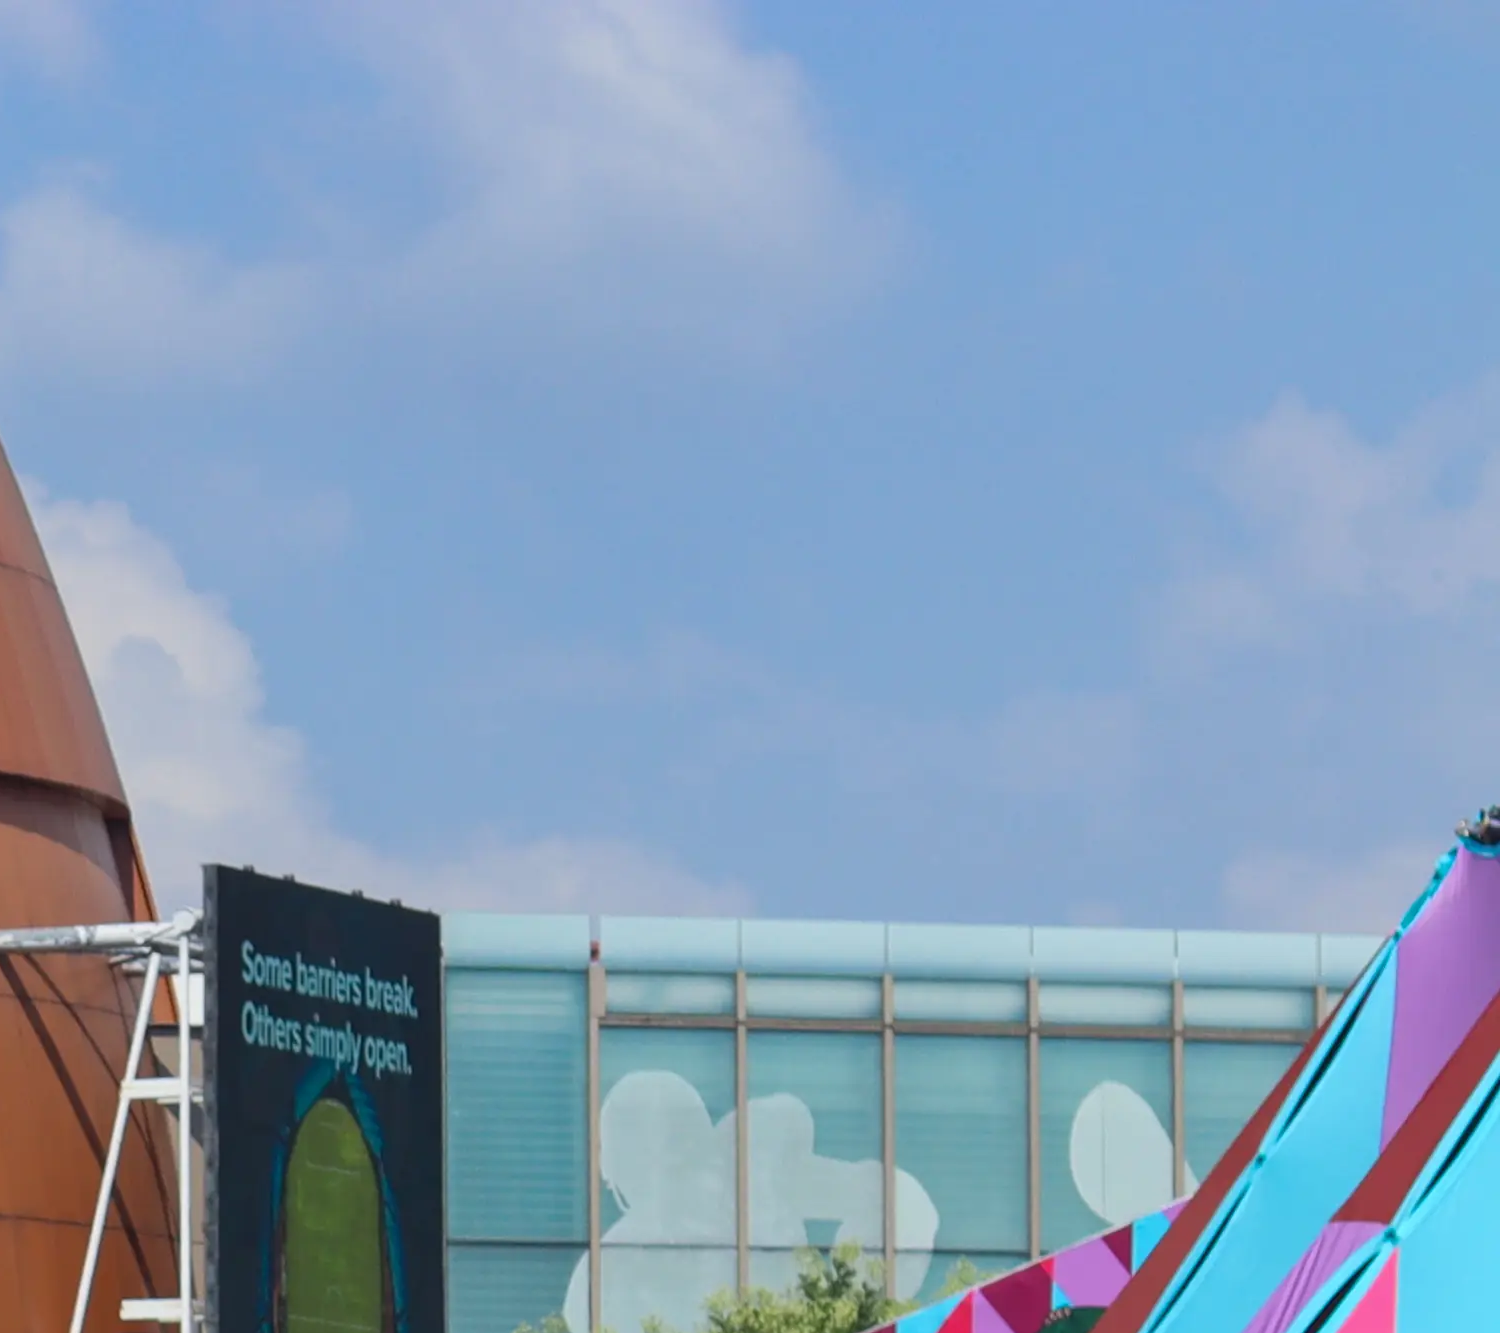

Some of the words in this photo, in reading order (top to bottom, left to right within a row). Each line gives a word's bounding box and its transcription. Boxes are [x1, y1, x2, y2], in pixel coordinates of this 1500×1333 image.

[241, 940, 293, 993] Some
[296, 951, 362, 1007] barriers
[365, 967, 419, 1019] break.
[241, 1000, 303, 1052] Others
[304, 1013, 363, 1075] simply
[364, 1036, 413, 1079] open.
